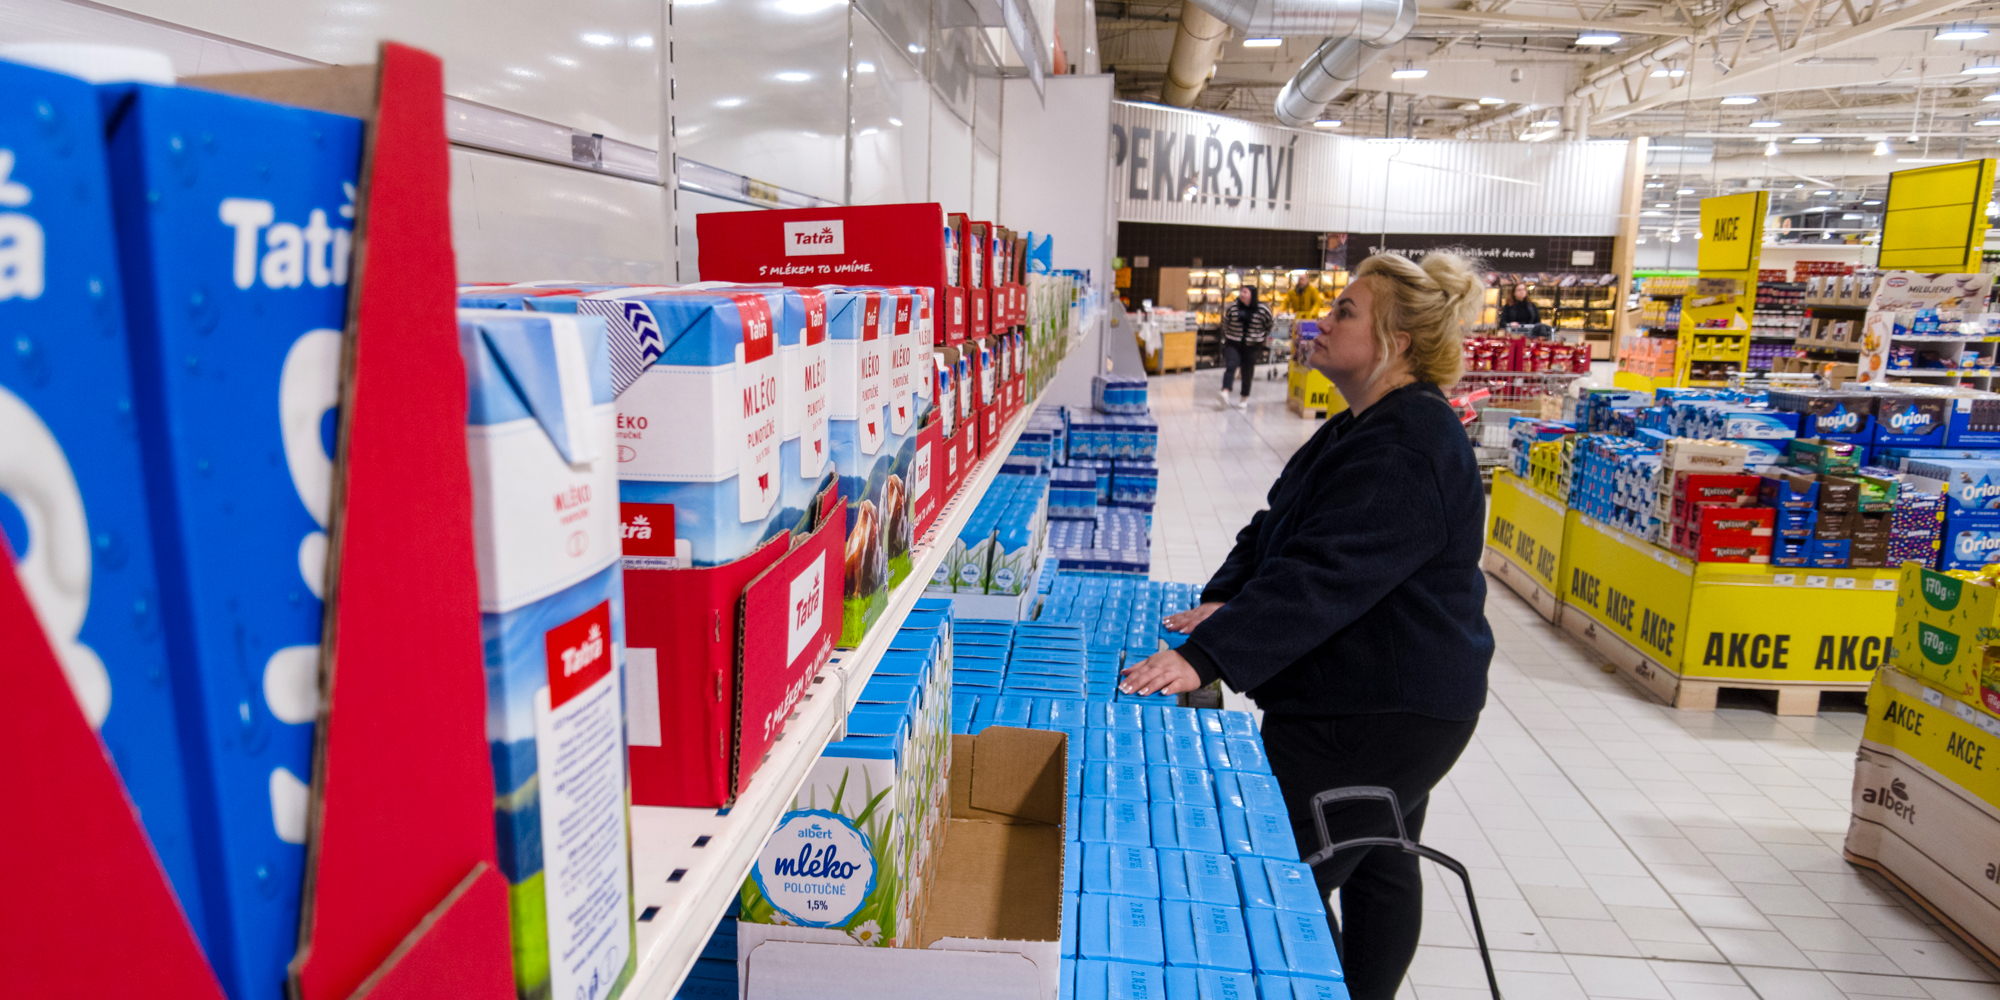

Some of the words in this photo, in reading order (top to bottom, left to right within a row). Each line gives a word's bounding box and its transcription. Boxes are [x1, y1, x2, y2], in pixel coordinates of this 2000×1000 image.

[795, 232, 834, 245] Tatra
[1713, 216, 1740, 242] AKCE
[1501, 248, 1535, 259] denně
[759, 265, 768, 276] S
[770, 263, 814, 276] MLÉKEM
[818, 264, 831, 274] TO
[861, 350, 880, 380] MLÉKO
[892, 343, 910, 369] MLÉKO
[743, 372, 776, 419] MLÉKO
[616, 412, 648, 430] ÉKO
[1891, 411, 1930, 429] Orion
[619, 521, 652, 540] tra
[1493, 516, 1514, 550] AKCE
[1516, 530, 1535, 566] AKCE
[1537, 545, 1556, 583] AKCE
[797, 588, 820, 631] Tatra
[1571, 567, 1600, 609] AKCE
[1606, 586, 1635, 632] AKCE
[1640, 608, 1675, 657] AKCE
[1703, 632, 1791, 670] AKCE
[805, 662, 813, 681] TO
[1883, 701, 1924, 736] AKCE
[1946, 731, 1985, 771] AKCE
[1862, 787, 1916, 825] albert
[798, 828, 832, 840] albert
[774, 842, 861, 880] mléko
[784, 881, 846, 896] POLOTUČNÉ
[806, 899, 828, 912] 1,5%
